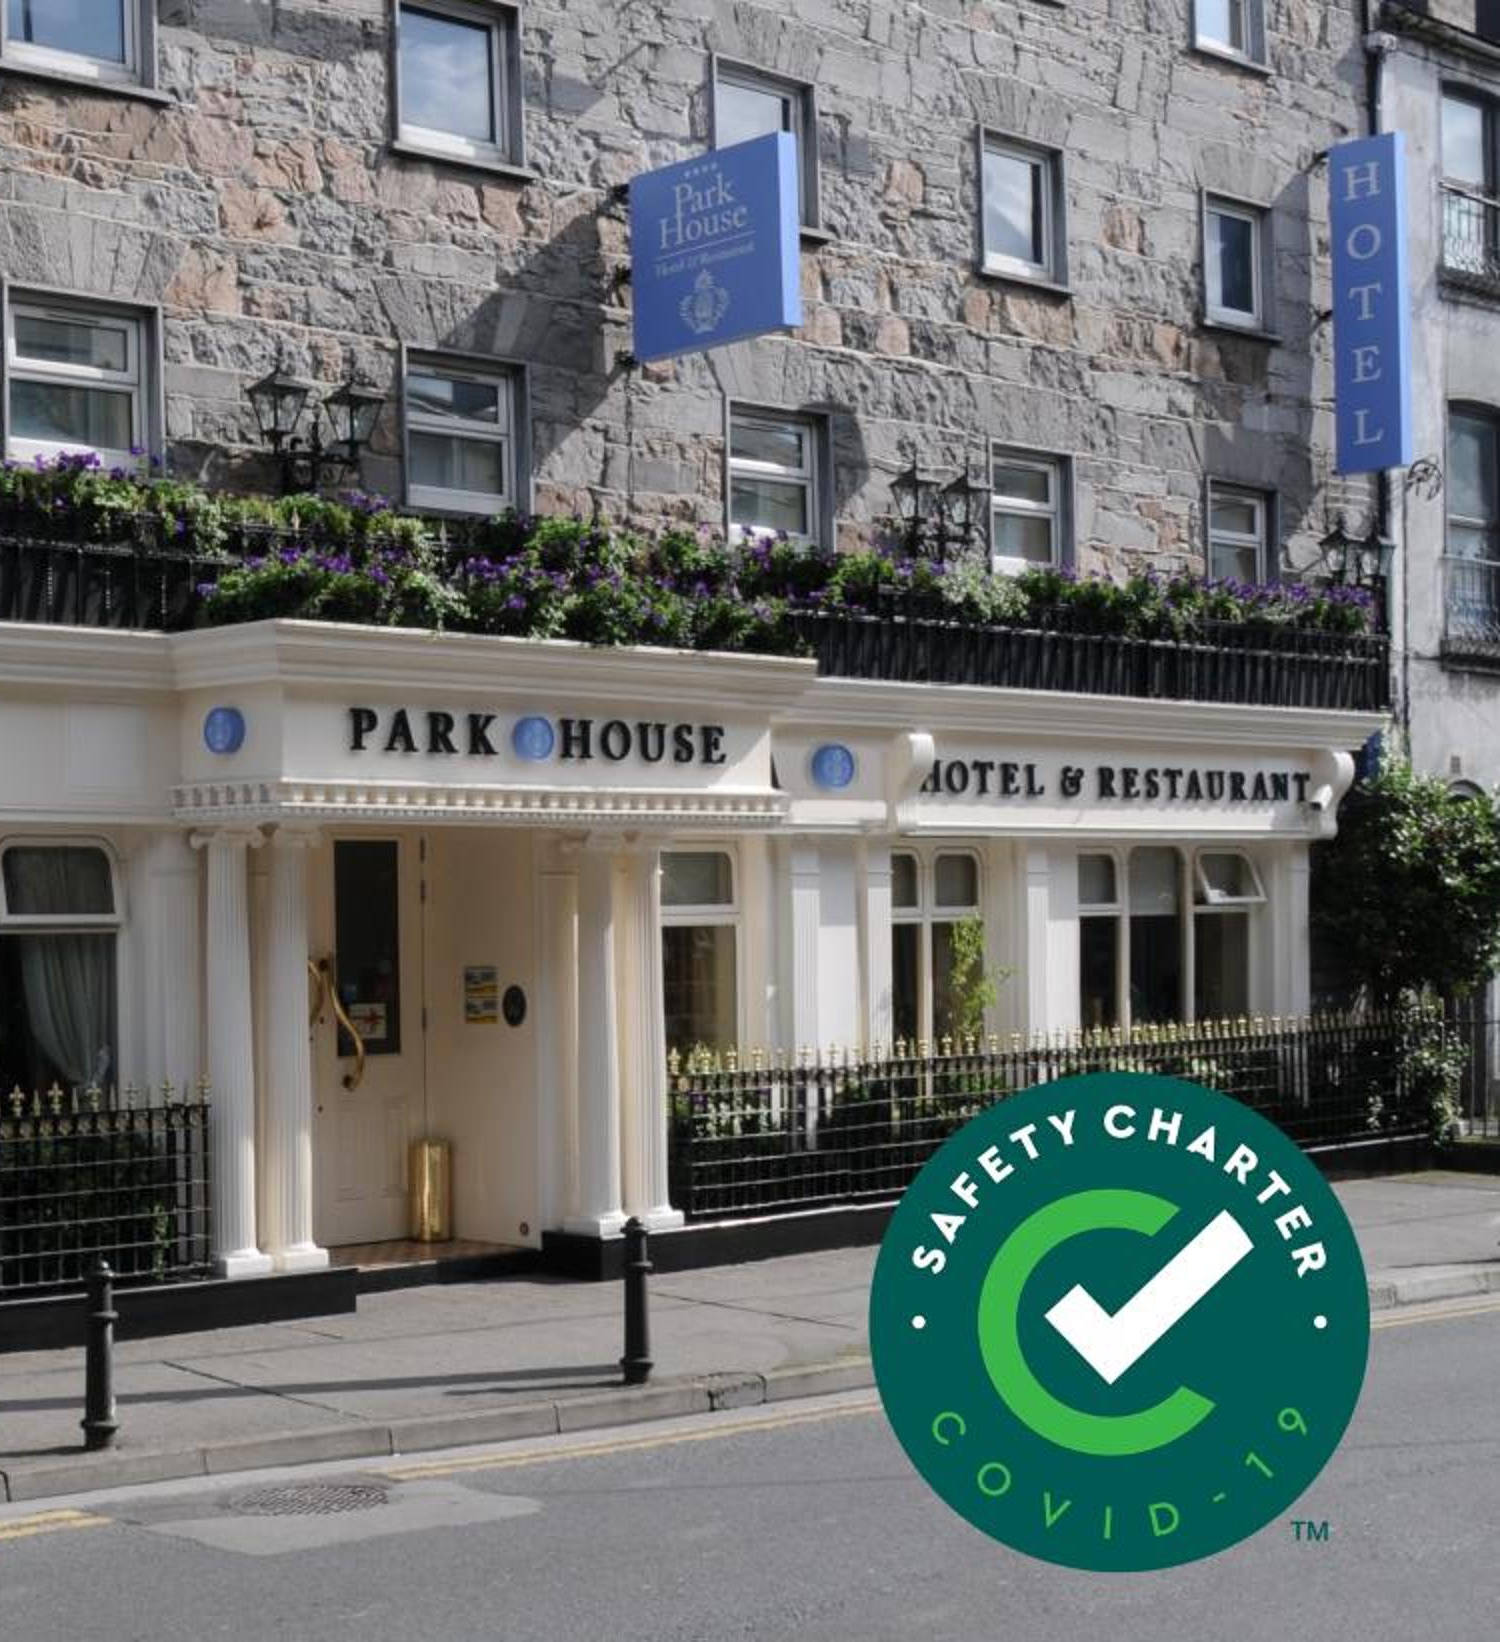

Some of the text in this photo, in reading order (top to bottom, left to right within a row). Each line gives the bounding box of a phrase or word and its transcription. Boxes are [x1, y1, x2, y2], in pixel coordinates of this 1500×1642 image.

[673, 171, 735, 215] Park
[660, 206, 748, 249] House
[1343, 161, 1384, 445] HOTEL
[349, 707, 727, 765] PARK HOUSE
[1060, 766, 1084, 797] &
[1097, 766, 1311, 803] RESTAURANT
